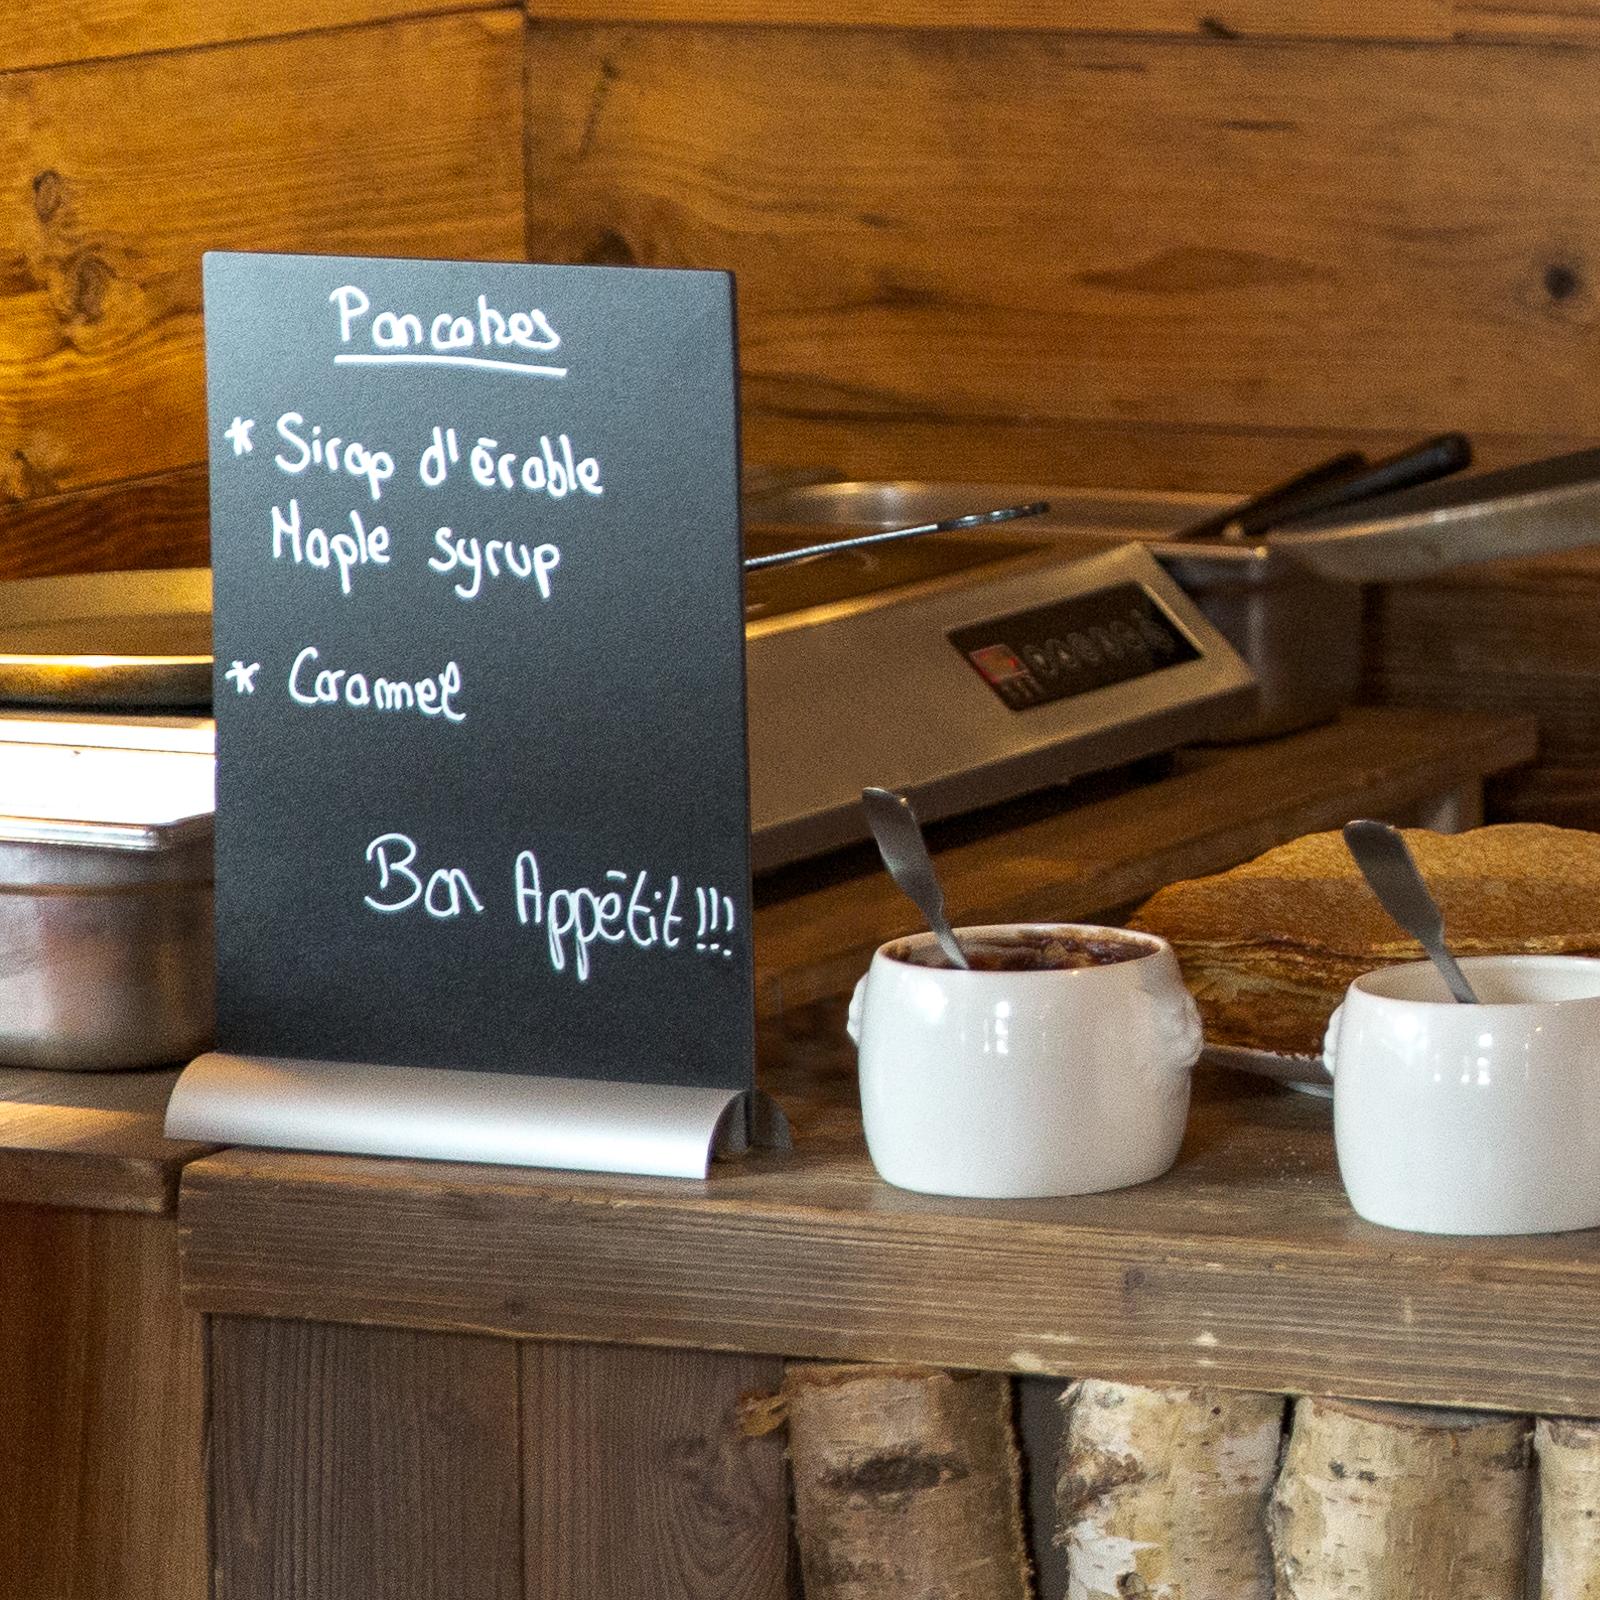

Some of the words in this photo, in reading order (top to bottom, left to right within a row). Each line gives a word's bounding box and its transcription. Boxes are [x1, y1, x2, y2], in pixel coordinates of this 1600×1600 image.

[329, 285, 562, 352] Pancakes
[274, 411, 395, 501] Sirop
[270, 498, 391, 596] Maple
[427, 526, 562, 600] syrup
[288, 646, 467, 724] Caramel
[363, 832, 485, 920] Bon
